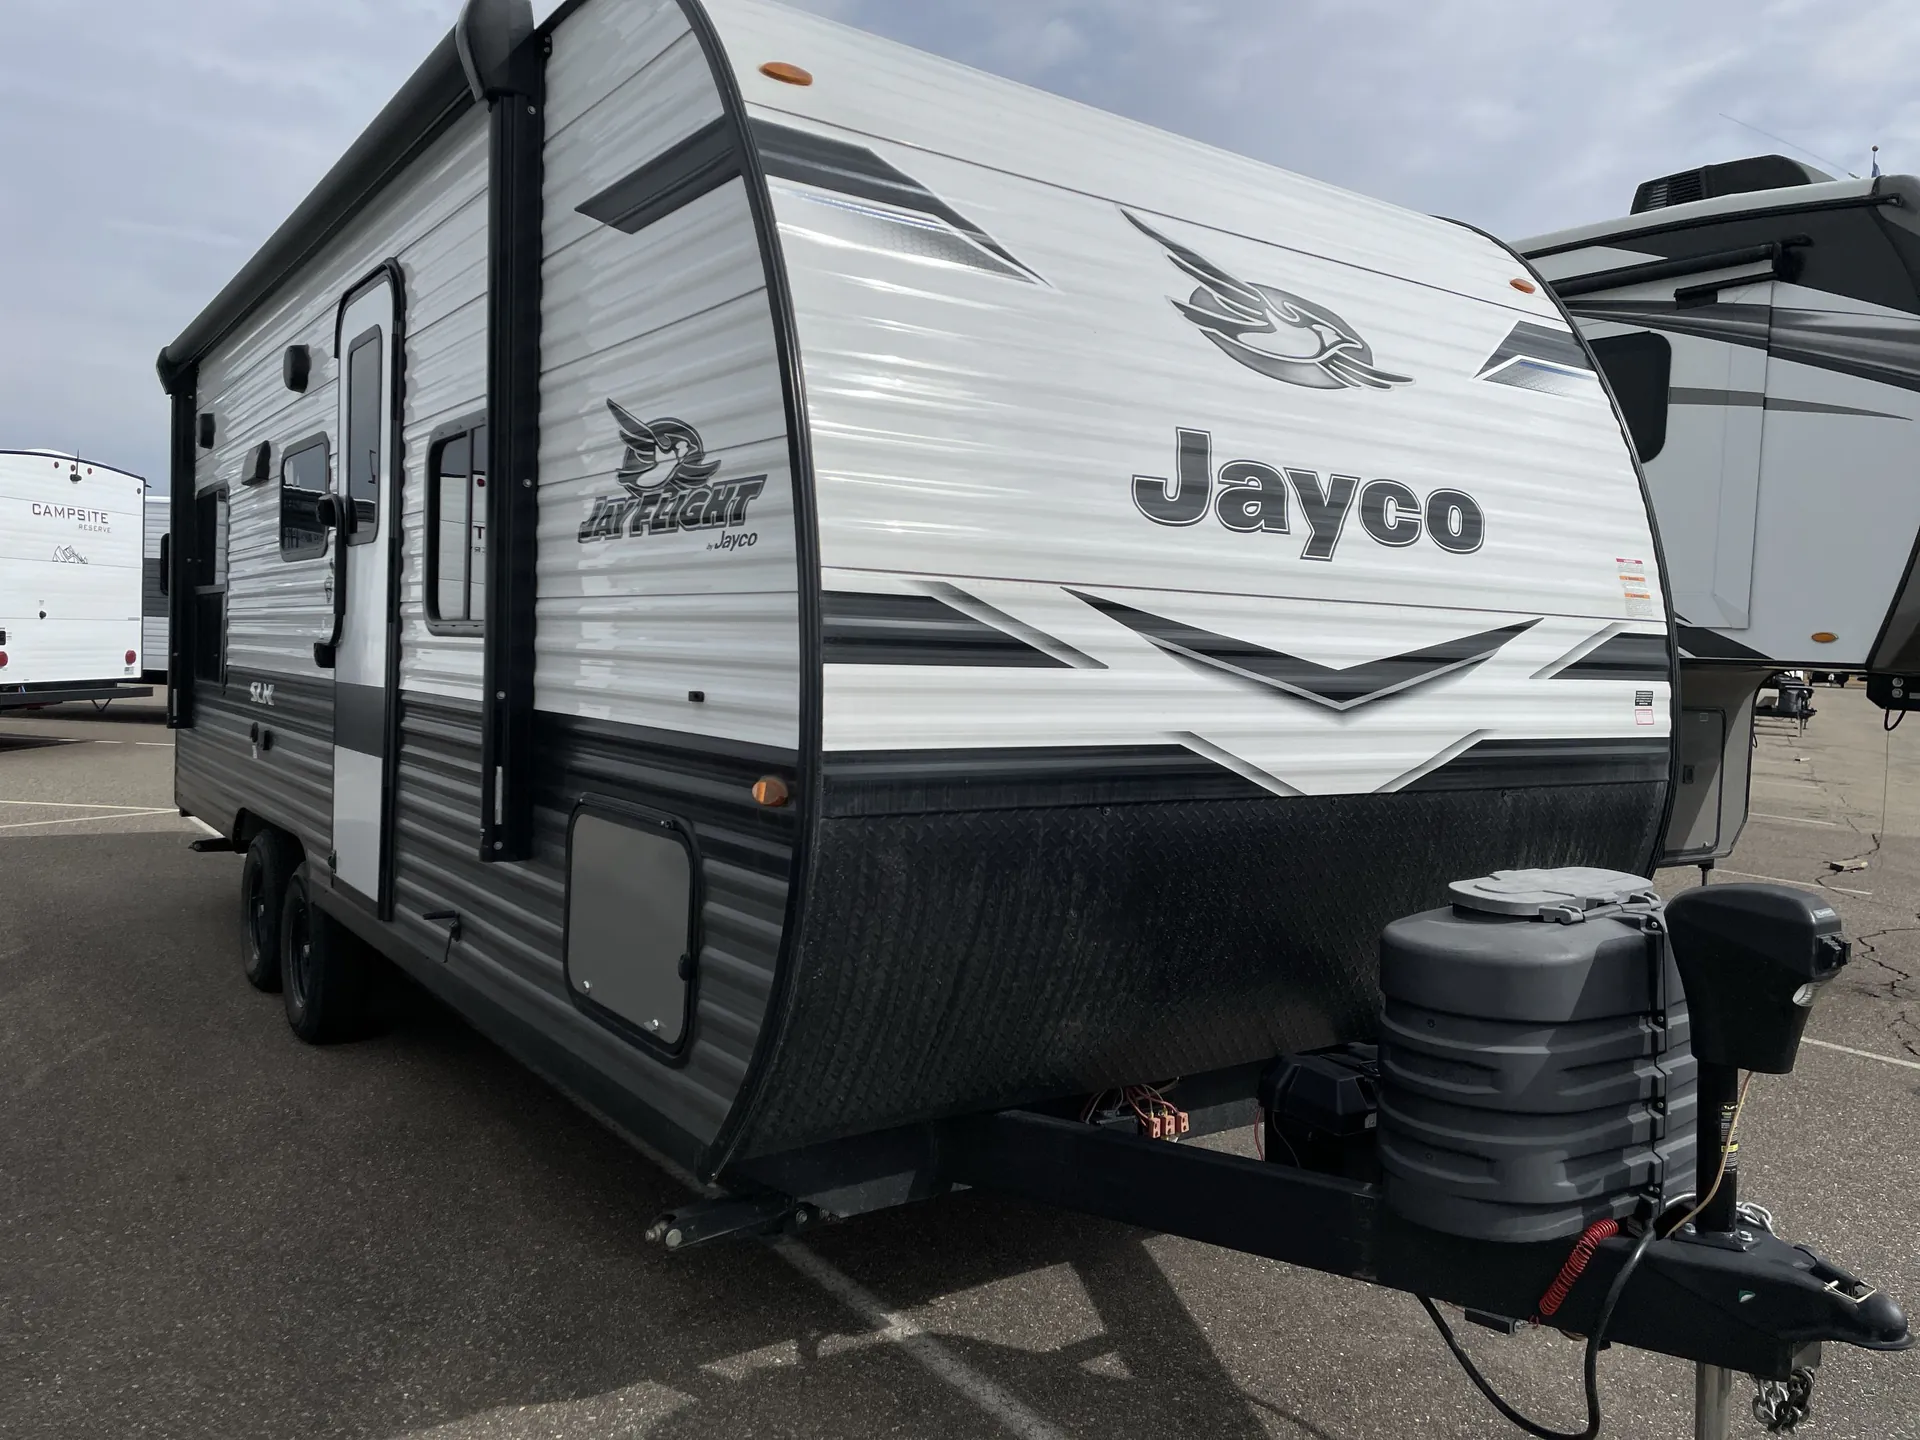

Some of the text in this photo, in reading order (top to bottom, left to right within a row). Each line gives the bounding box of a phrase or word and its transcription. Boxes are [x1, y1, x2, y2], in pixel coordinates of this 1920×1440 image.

[1131, 426, 1485, 561] Jayco
[32, 503, 109, 524] CAMPSITE
[578, 474, 768, 543] JAY FLIGHT
[78, 523, 112, 534] RESERVE
[714, 530, 758, 551] Jayco
